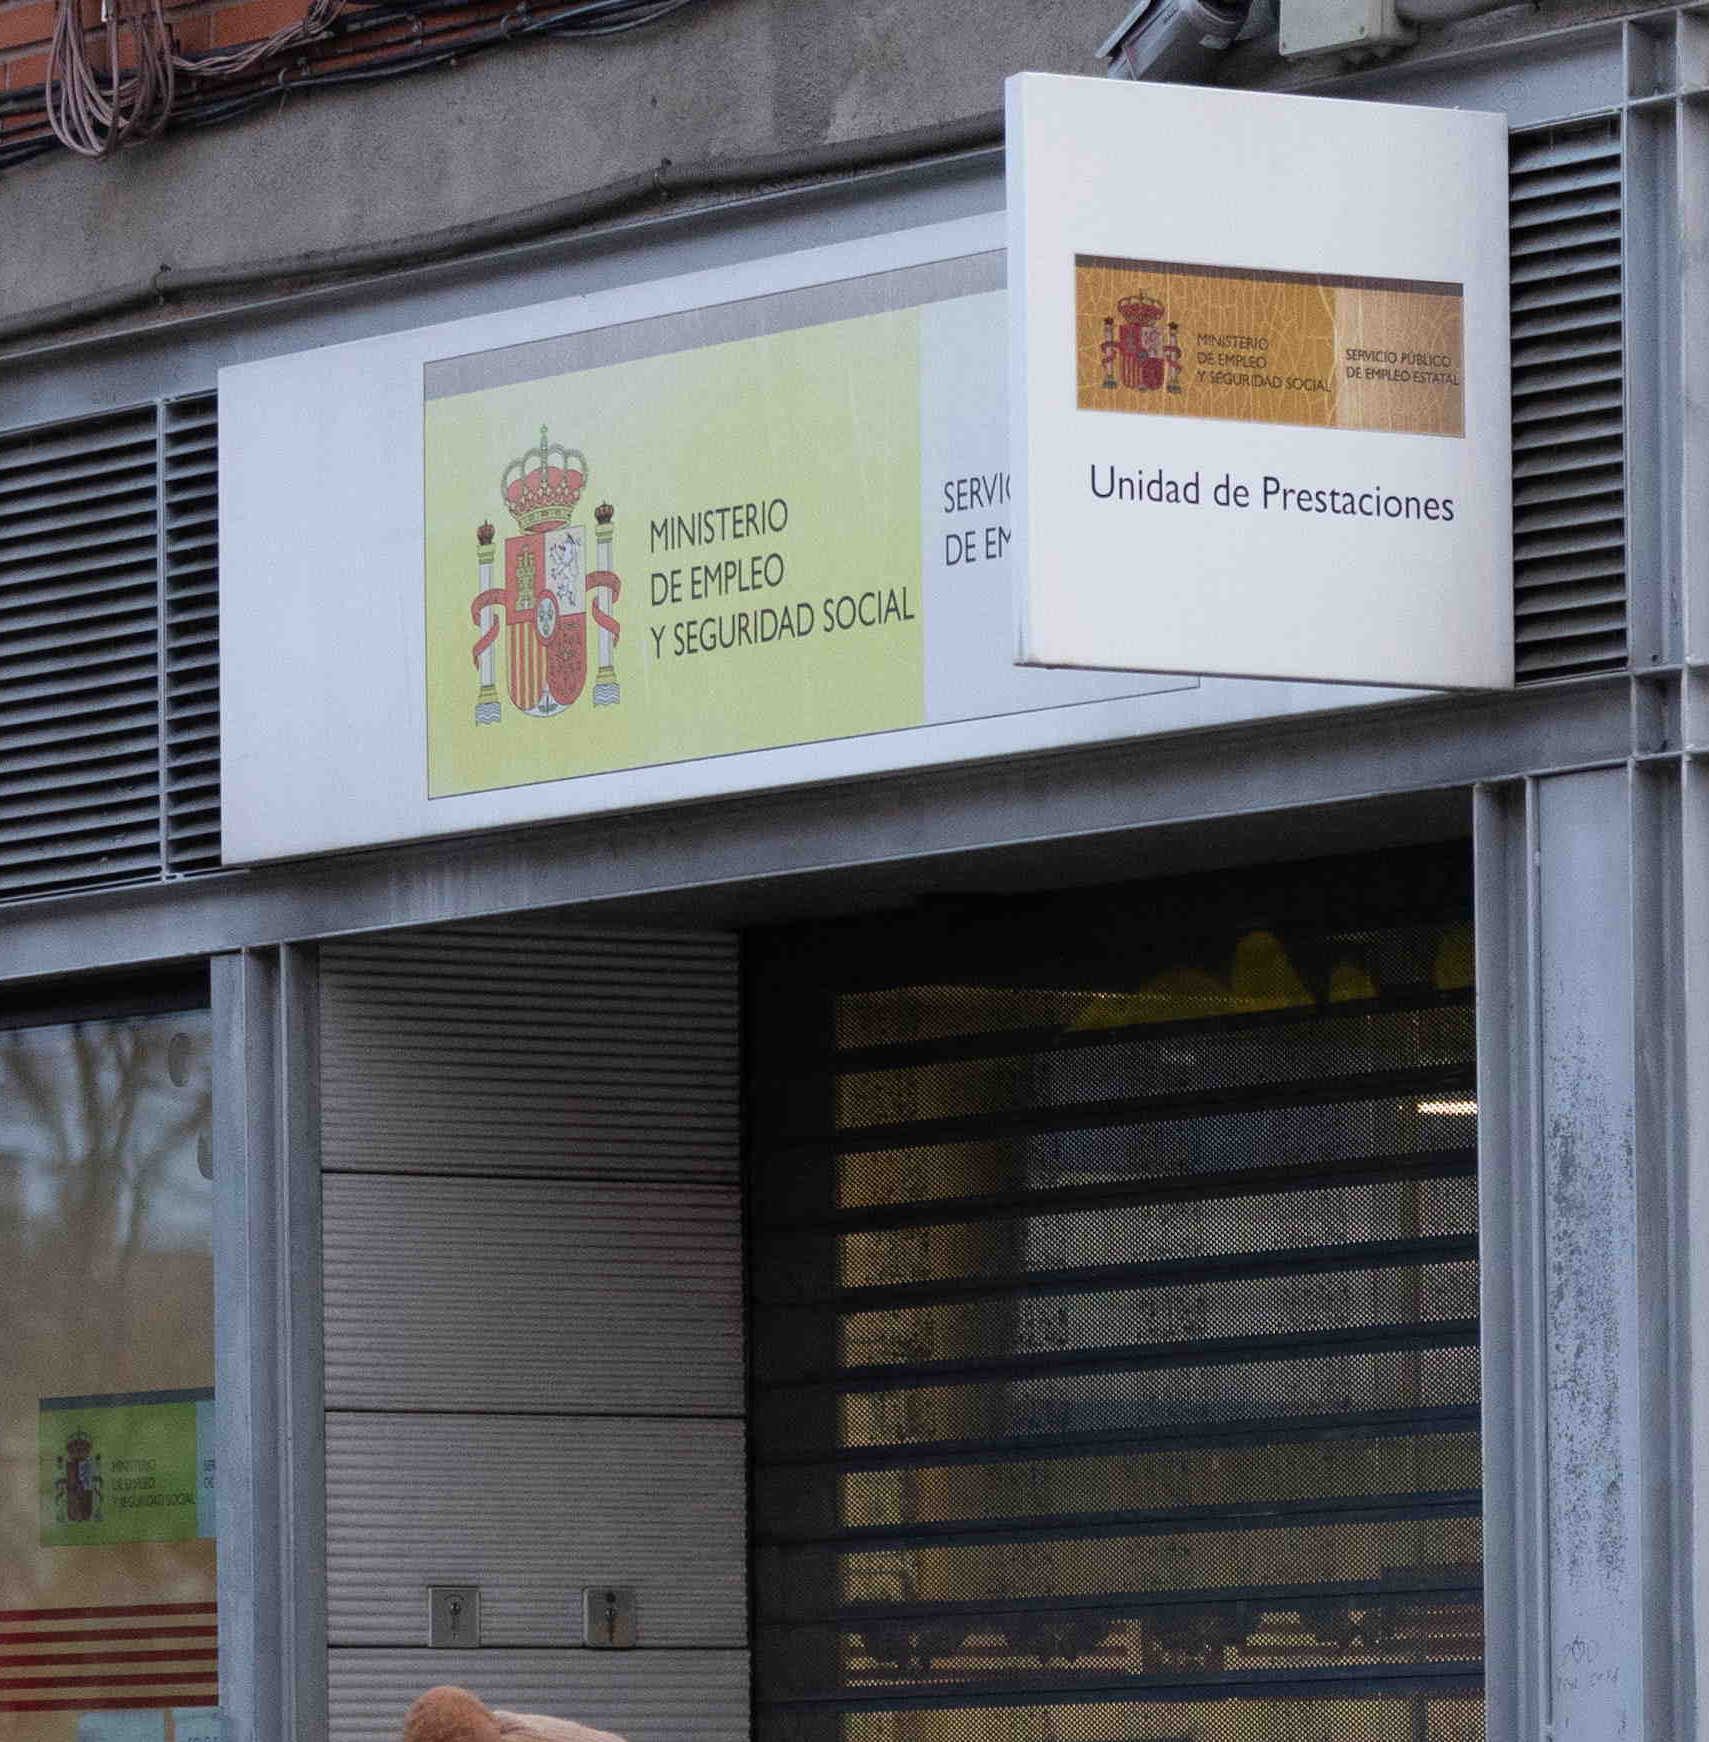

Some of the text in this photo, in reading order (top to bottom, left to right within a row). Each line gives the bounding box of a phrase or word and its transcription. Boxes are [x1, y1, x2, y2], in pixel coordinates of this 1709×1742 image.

[1197, 334, 1269, 350] MINISTERIO
[1197, 352, 1267, 369] DE EMPLEO
[1346, 349, 1397, 364] SERVICIO
[1197, 371, 1332, 393] Y SEGURIDAD SOCIAL
[1347, 366, 1460, 386] DE EMPLEO ESTATAL
[1090, 464, 1455, 521] Unidad de Prestaciones
[650, 498, 789, 553] MINISTERIO
[946, 531, 977, 566] DE
[651, 553, 784, 606] DE EMPLEO
[650, 587, 915, 659] Y SEGURIDAD SOCIAL
